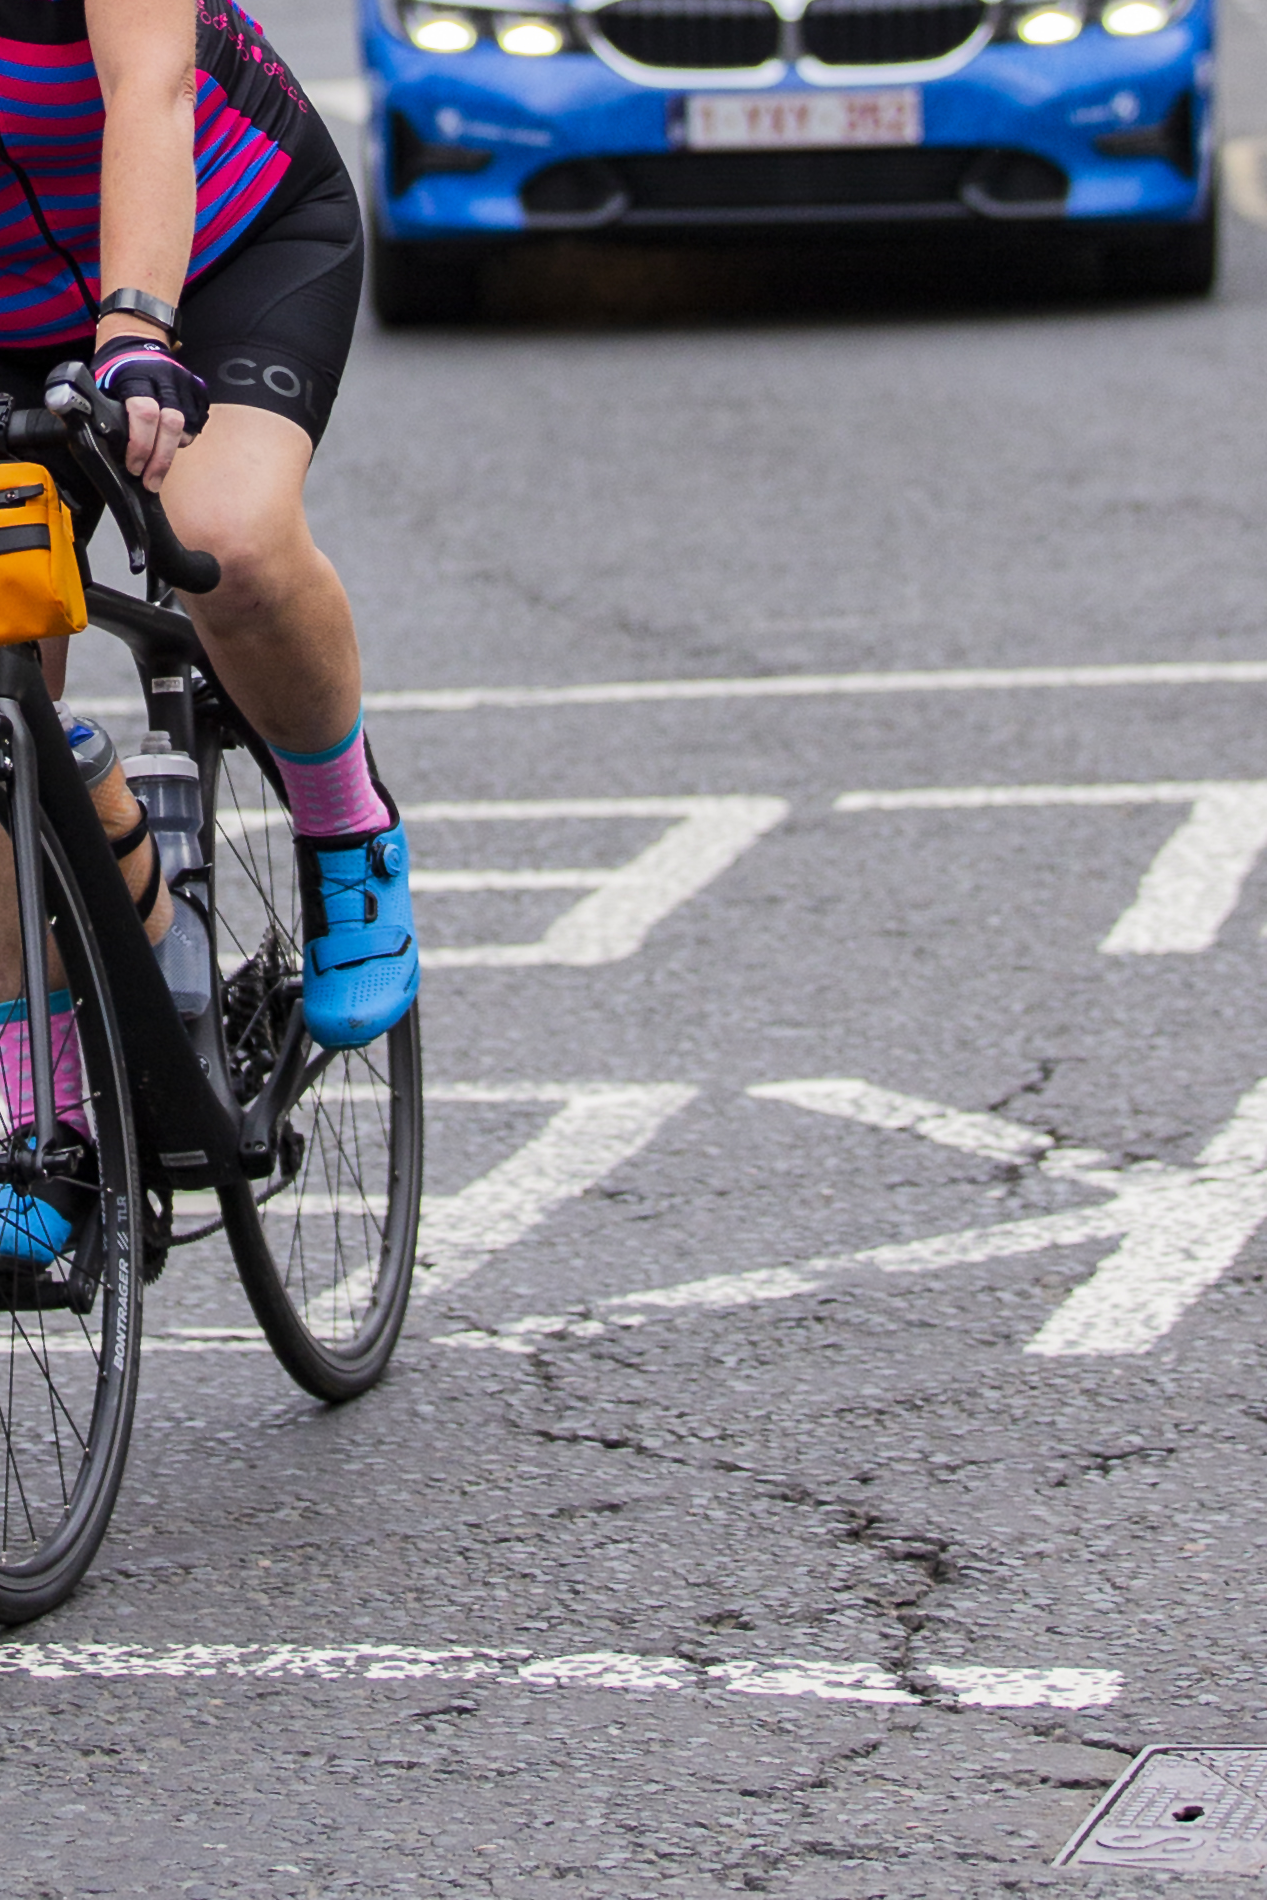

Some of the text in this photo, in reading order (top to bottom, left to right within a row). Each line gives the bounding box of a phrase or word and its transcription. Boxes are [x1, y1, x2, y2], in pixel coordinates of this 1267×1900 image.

[217, 357, 319, 421] COL
[113, 1195, 130, 1373] BONTRAGER TLR
